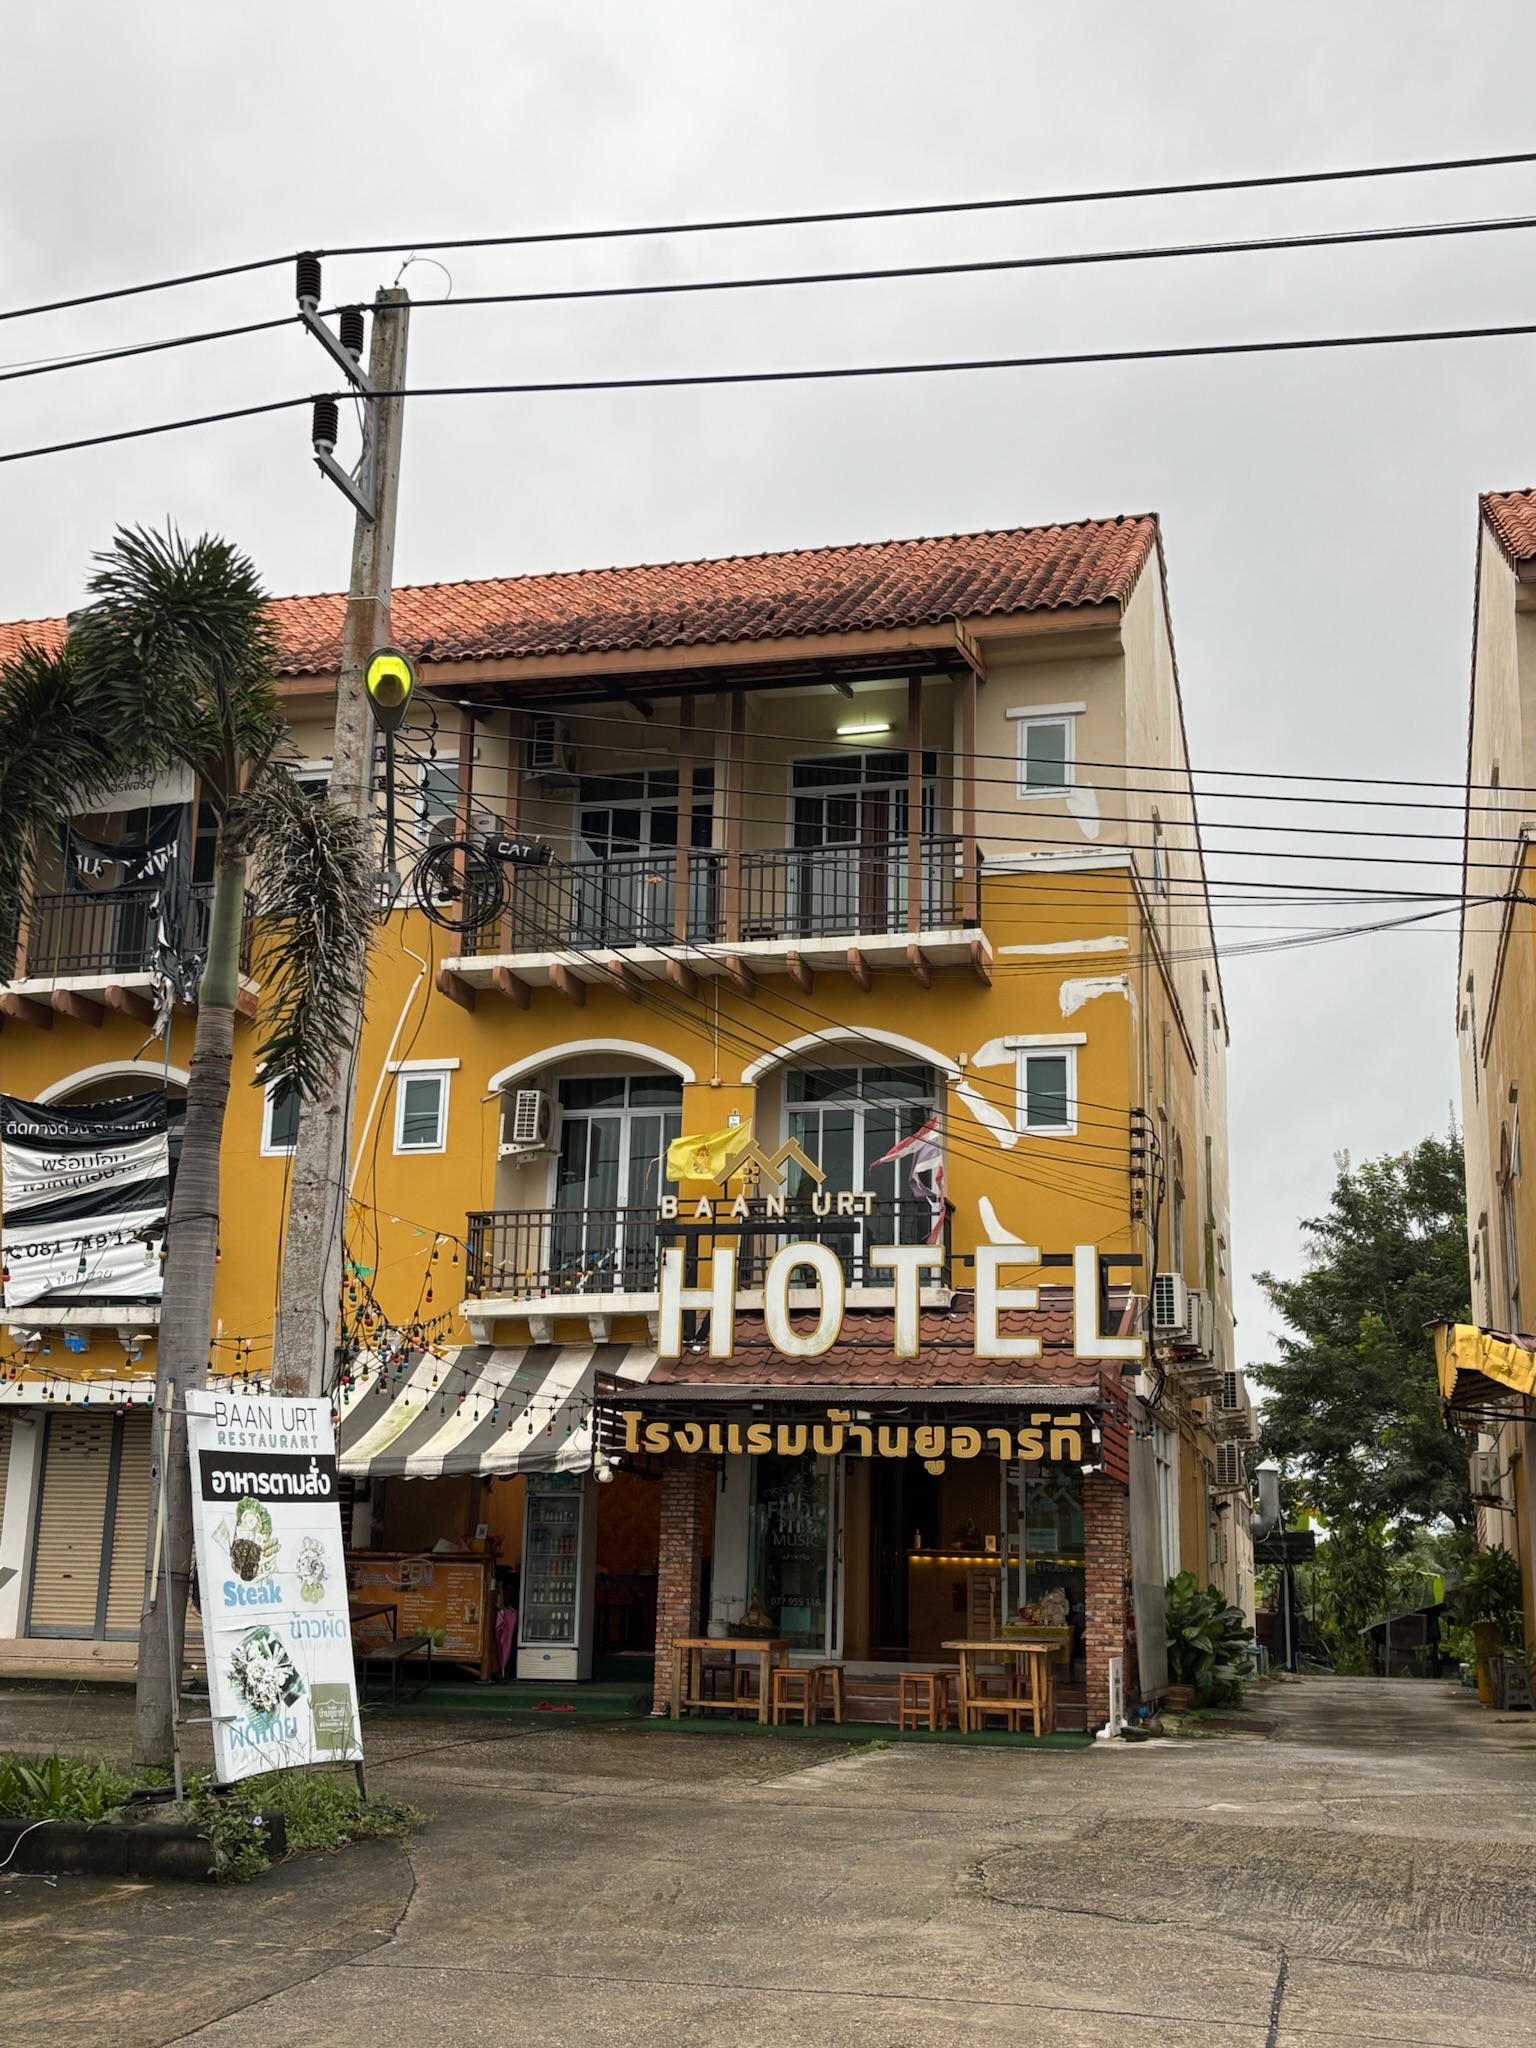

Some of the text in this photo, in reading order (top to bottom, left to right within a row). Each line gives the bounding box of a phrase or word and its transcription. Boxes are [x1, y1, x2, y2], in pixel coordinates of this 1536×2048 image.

[497, 841, 533, 858] CAT
[660, 1191, 877, 1220] BAAN URT
[657, 1241, 1147, 1360] HOTEL
[214, 1401, 318, 1432] BAAN URT
[217, 1430, 319, 1449] RESTAURANT
[621, 1408, 1082, 1476] โรงแรมบ้านยูอาร์ที
[211, 1456, 331, 1496] อาหารตามสั่ง
[773, 1534, 820, 1547] MUSIC
[1043, 1564, 1074, 1573] HOURS
[223, 1580, 282, 1607] Steak
[770, 1597, 821, 1607] 077 955 118
[289, 1610, 347, 1640] ข้าวผัด
[229, 1711, 299, 1751] ผัดไทย
